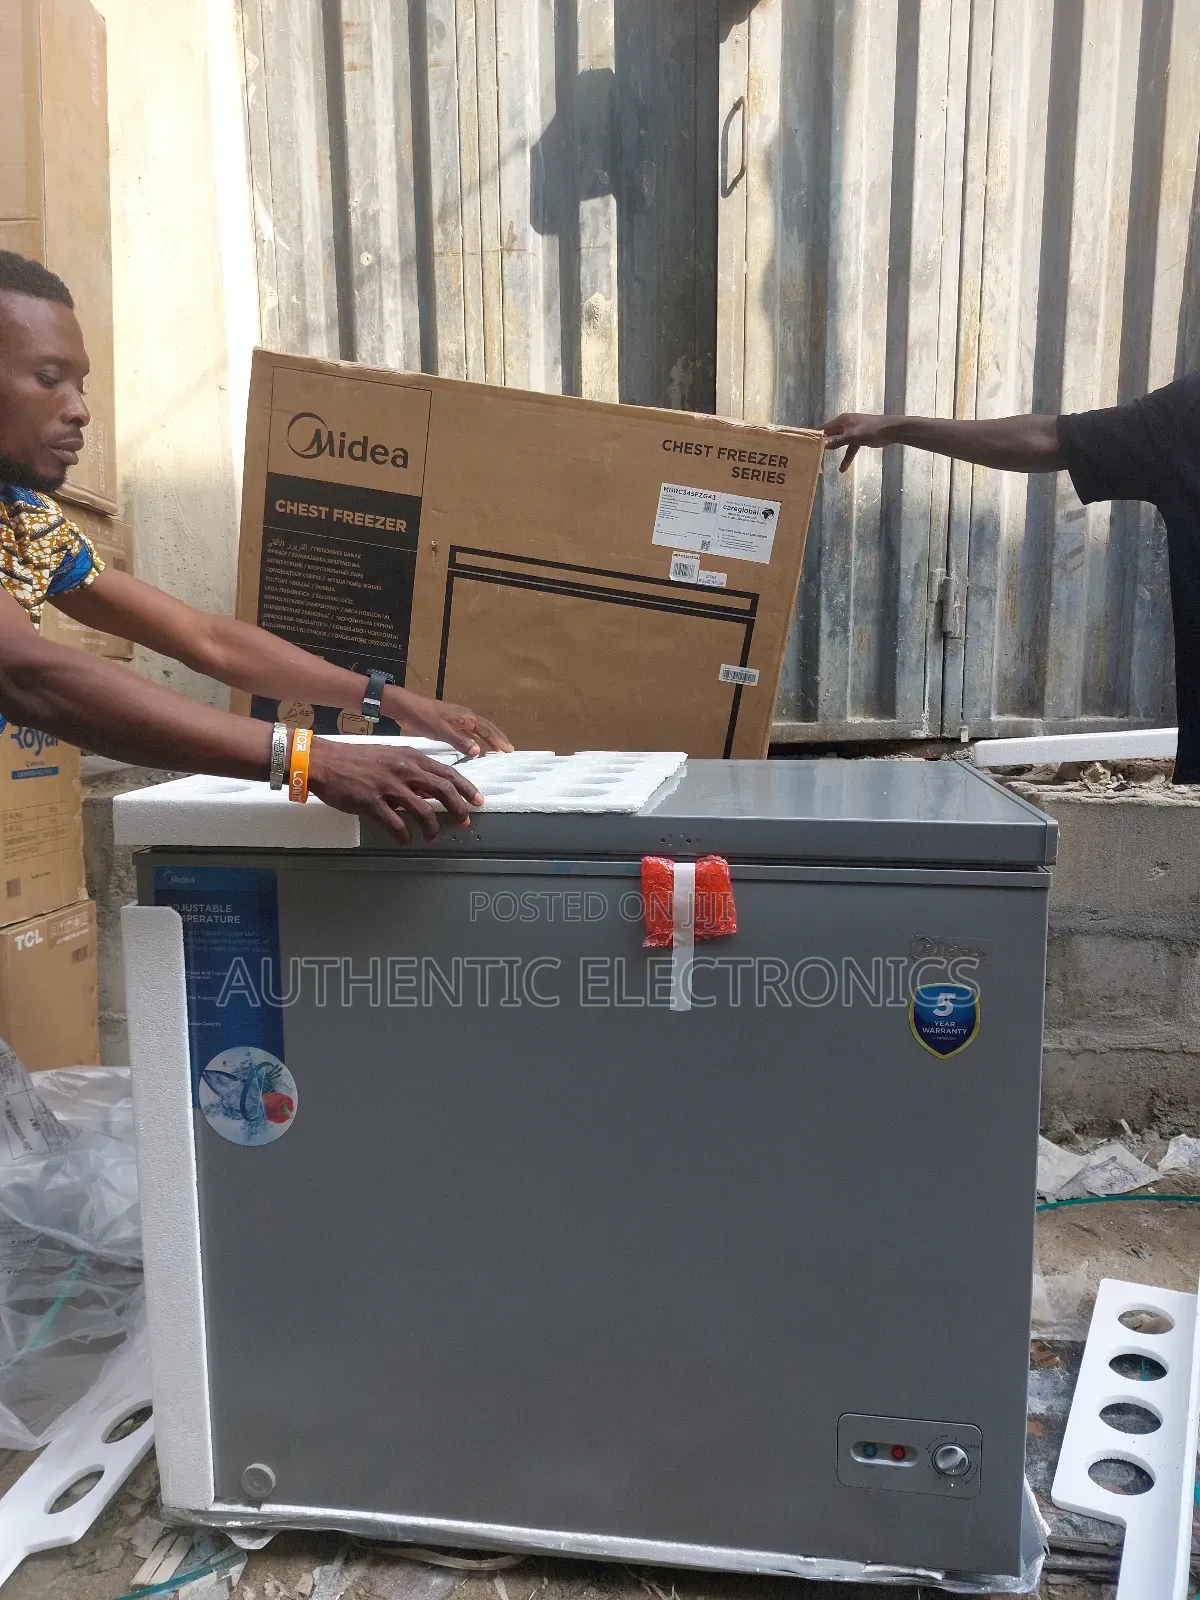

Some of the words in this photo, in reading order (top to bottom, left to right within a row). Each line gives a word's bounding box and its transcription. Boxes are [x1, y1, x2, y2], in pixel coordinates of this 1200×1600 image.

[287, 412, 409, 469] Midea
[662, 439, 713, 457] CHEST
[717, 447, 789, 469] FREEZER
[731, 466, 786, 485] SERIES
[275, 499, 329, 520] CHEST
[333, 508, 407, 533] FREEZER
[163, 870, 196, 885] Midea
[168, 904, 232, 913] DJUSTABLE
[15, 928, 44, 951] TCL
[932, 993, 957, 1018] 5
[922, 1027, 968, 1036] WARRANTY
